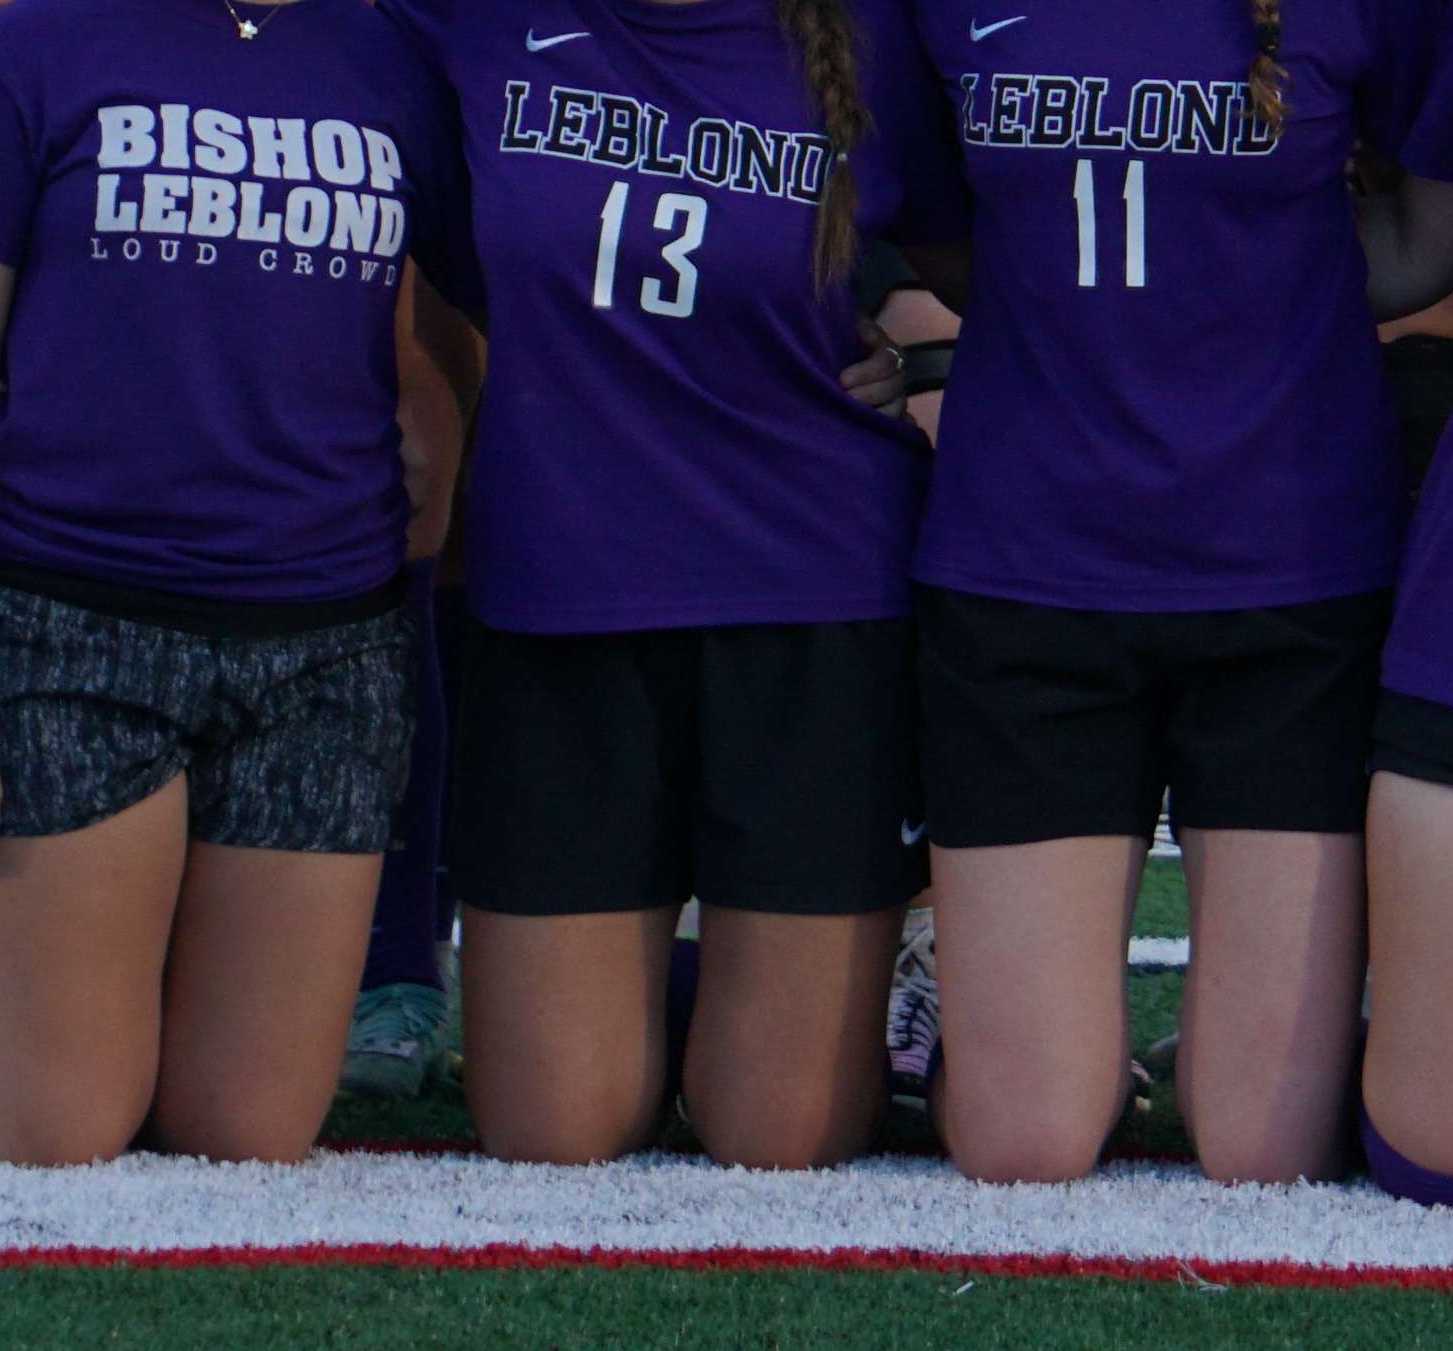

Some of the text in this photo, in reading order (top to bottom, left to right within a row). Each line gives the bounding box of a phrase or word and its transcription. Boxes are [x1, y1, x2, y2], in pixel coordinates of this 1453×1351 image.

[97, 103, 403, 192] BISHOP
[499, 79, 833, 206] LEBLOND
[960, 72, 1284, 156] LEBLOND
[94, 173, 406, 258] LEBLOND
[593, 180, 708, 319] 13
[1073, 158, 1145, 287] 11
[90, 237, 396, 287] LOUD CROWD
